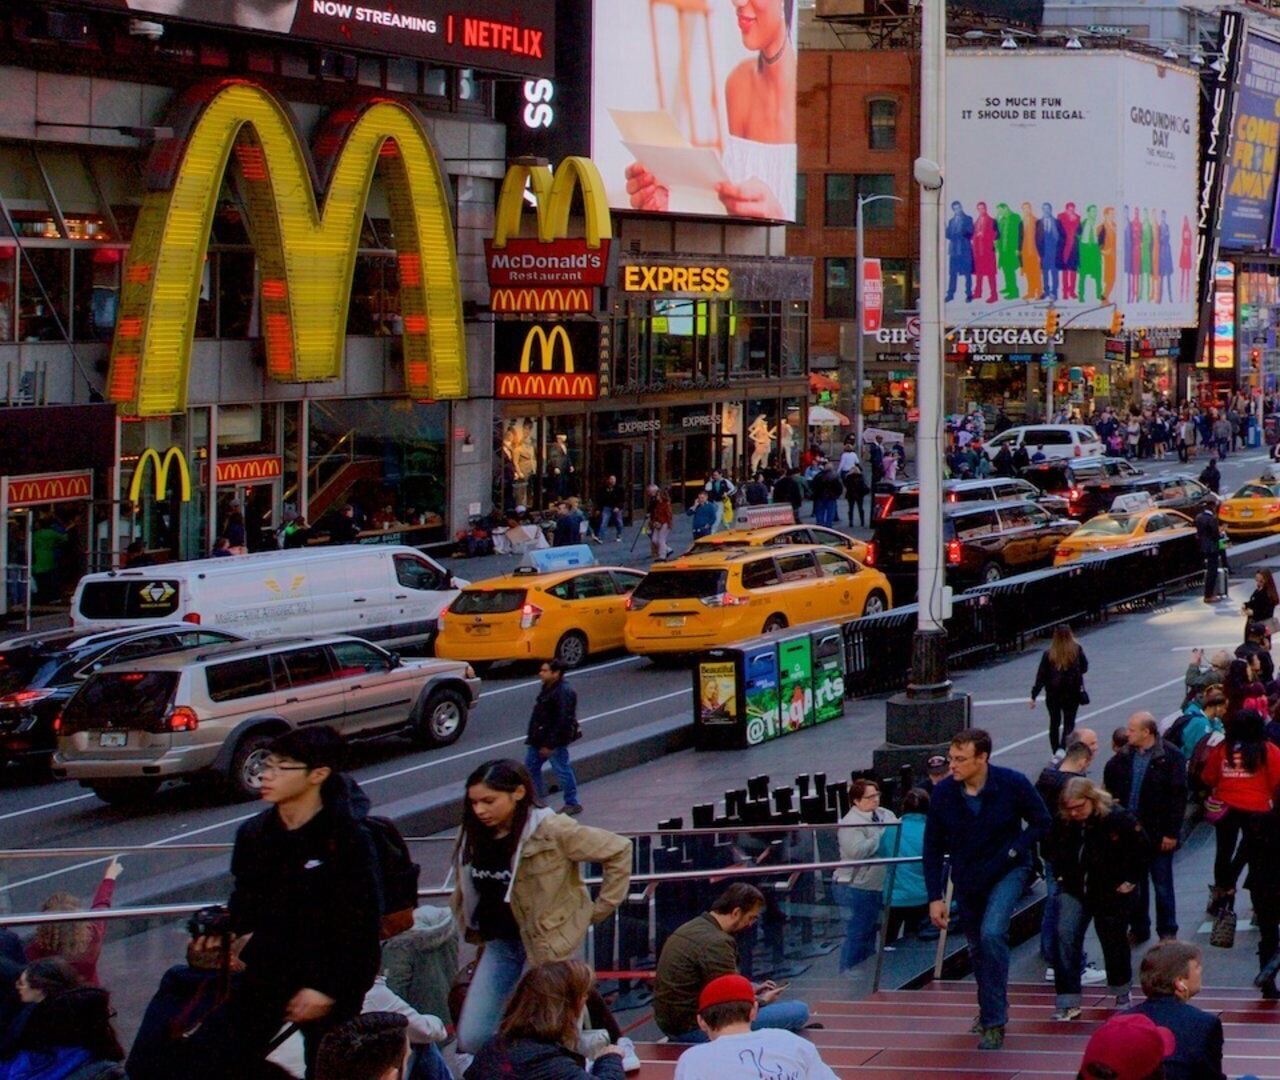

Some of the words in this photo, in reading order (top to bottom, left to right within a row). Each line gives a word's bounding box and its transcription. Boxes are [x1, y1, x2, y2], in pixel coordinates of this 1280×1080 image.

[355, 5, 438, 35] STREAMING
[463, 19, 543, 59] NETFLIX
[985, 97, 1000, 106] SO
[1005, 97, 1037, 106] MUCH
[1041, 97, 1061, 106] FUN
[961, 110, 972, 119] IT
[978, 110, 1019, 119] SHOULD
[1023, 110, 1036, 119] BE
[1130, 106, 1190, 135] GROUNDHOG
[1152, 129, 1169, 148] DAY
[492, 254, 601, 269] McDonald's
[509, 271, 582, 281] Restaurant
[625, 265, 730, 292] EXPRESS
[958, 329, 1064, 345] LUGGAGE
[968, 344, 986, 353] NY
[618, 420, 661, 433] EXPRESS
[682, 414, 722, 427] EXPRESS
